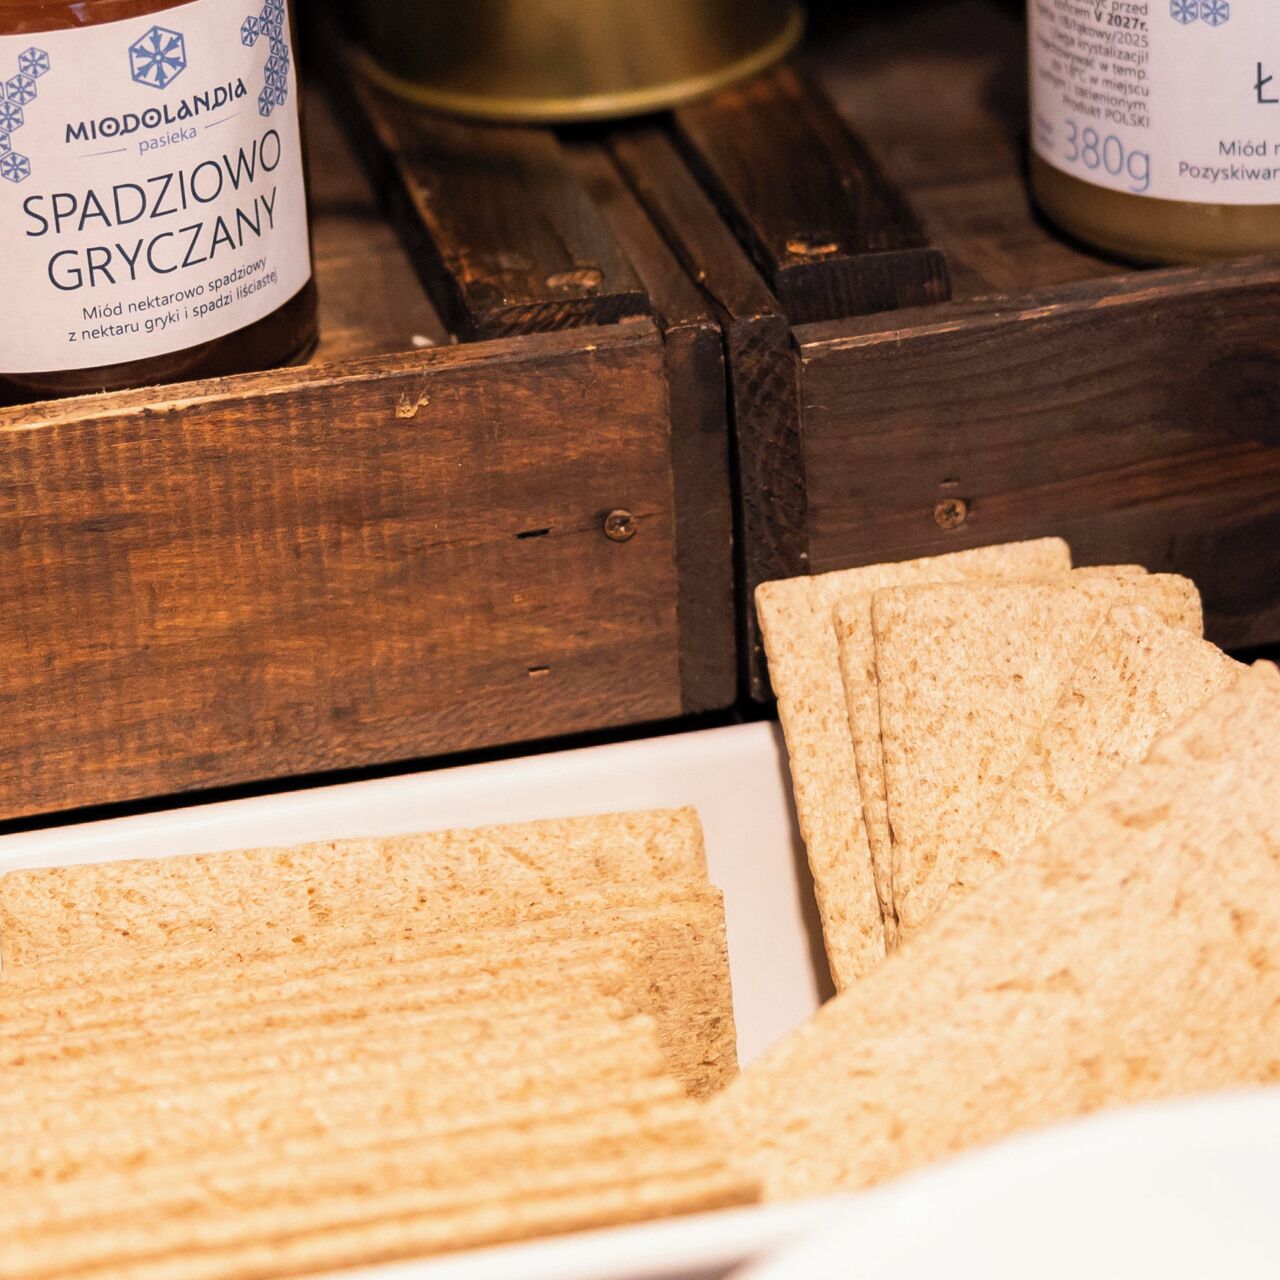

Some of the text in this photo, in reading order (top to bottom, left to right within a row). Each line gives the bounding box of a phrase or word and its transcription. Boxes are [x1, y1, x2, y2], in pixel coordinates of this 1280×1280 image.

[1094, 10, 1103, 23] V
[1107, 12, 1148, 32] 2027r.
[1111, 0, 1148, 17] przed
[1077, 38, 1149, 66] krystalizacji!
[1101, 74, 1149, 98] miejscu
[1112, 62, 1148, 81] temp.
[64, 78, 248, 144] MIODOLANDIA
[1104, 108, 1150, 128] POLSKI
[138, 124, 198, 156] pasieka
[1218, 138, 1267, 158] Miód
[1065, 119, 1150, 193] 380g
[22, 128, 281, 237] SPADZIOWO
[47, 186, 277, 292] GRYCZANY
[82, 256, 267, 320] Miód nektarowo spadziowy
[68, 331, 77, 342] z
[81, 321, 140, 341] nektaru
[144, 310, 180, 334] gryki
[192, 293, 233, 322] spadzi
[236, 266, 278, 302] liściastej
